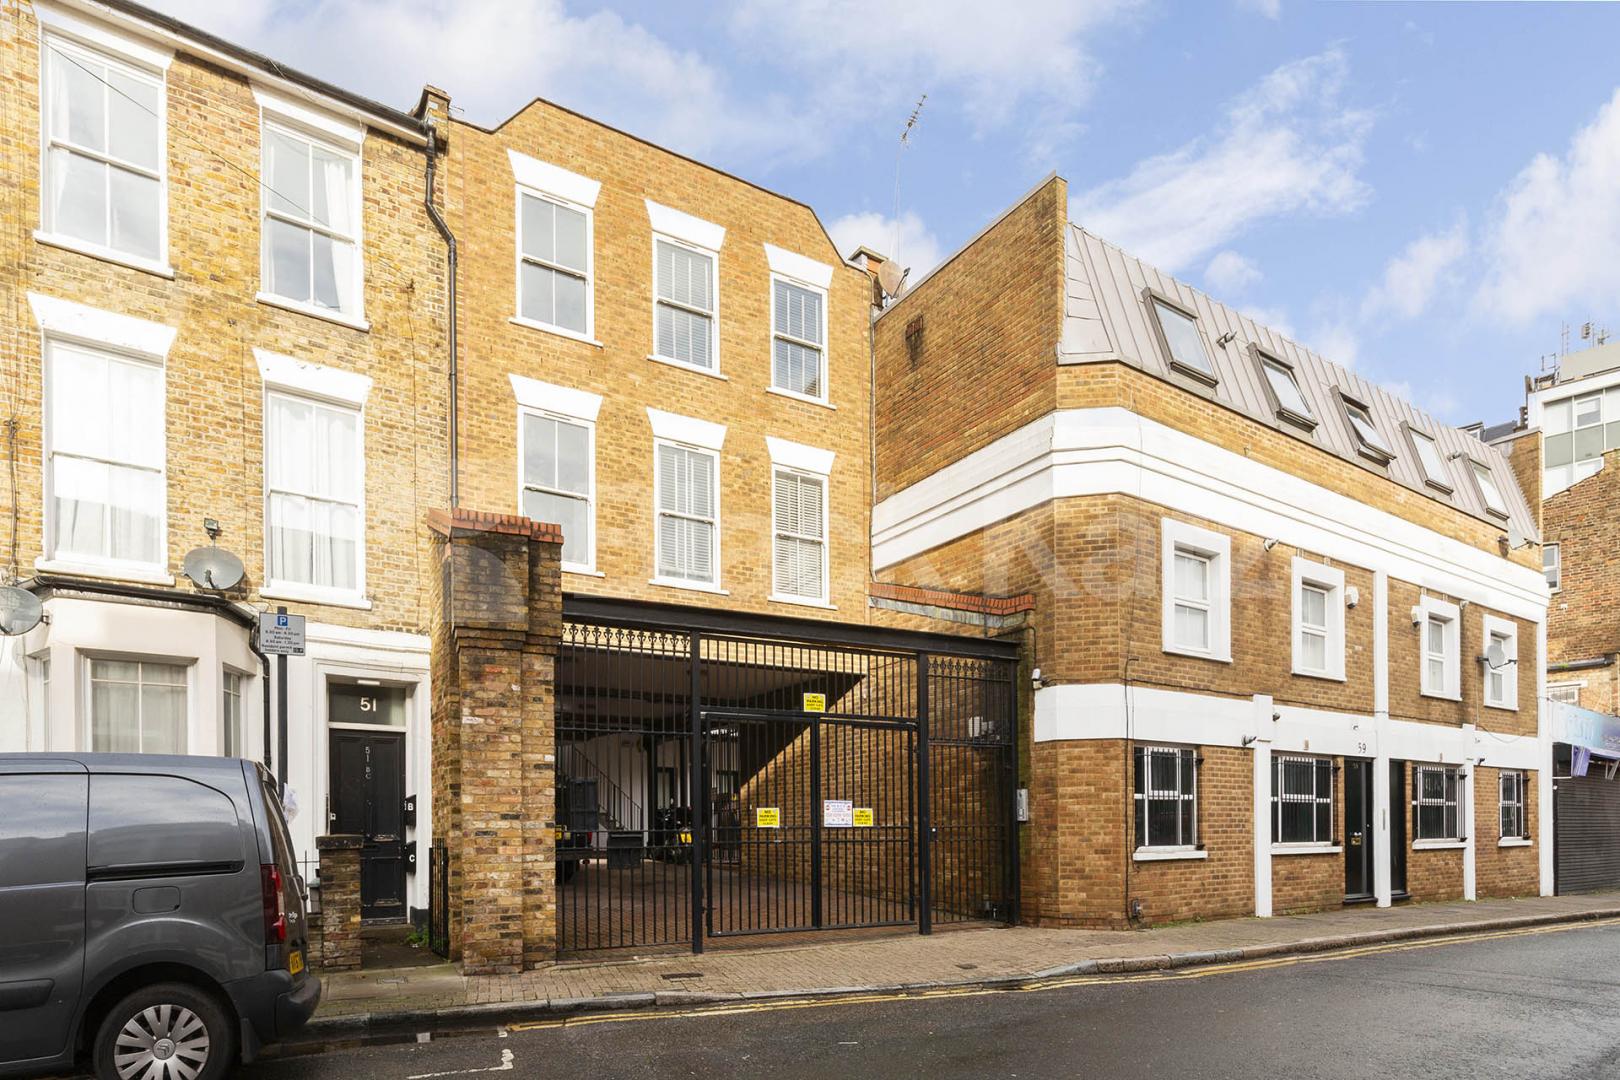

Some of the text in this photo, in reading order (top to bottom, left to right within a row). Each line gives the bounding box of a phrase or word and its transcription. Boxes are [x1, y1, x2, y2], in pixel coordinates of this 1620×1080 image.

[279, 617, 287, 626] P
[360, 696, 377, 712] 51
[1358, 742, 1367, 754] 59
[408, 854, 416, 863] C
